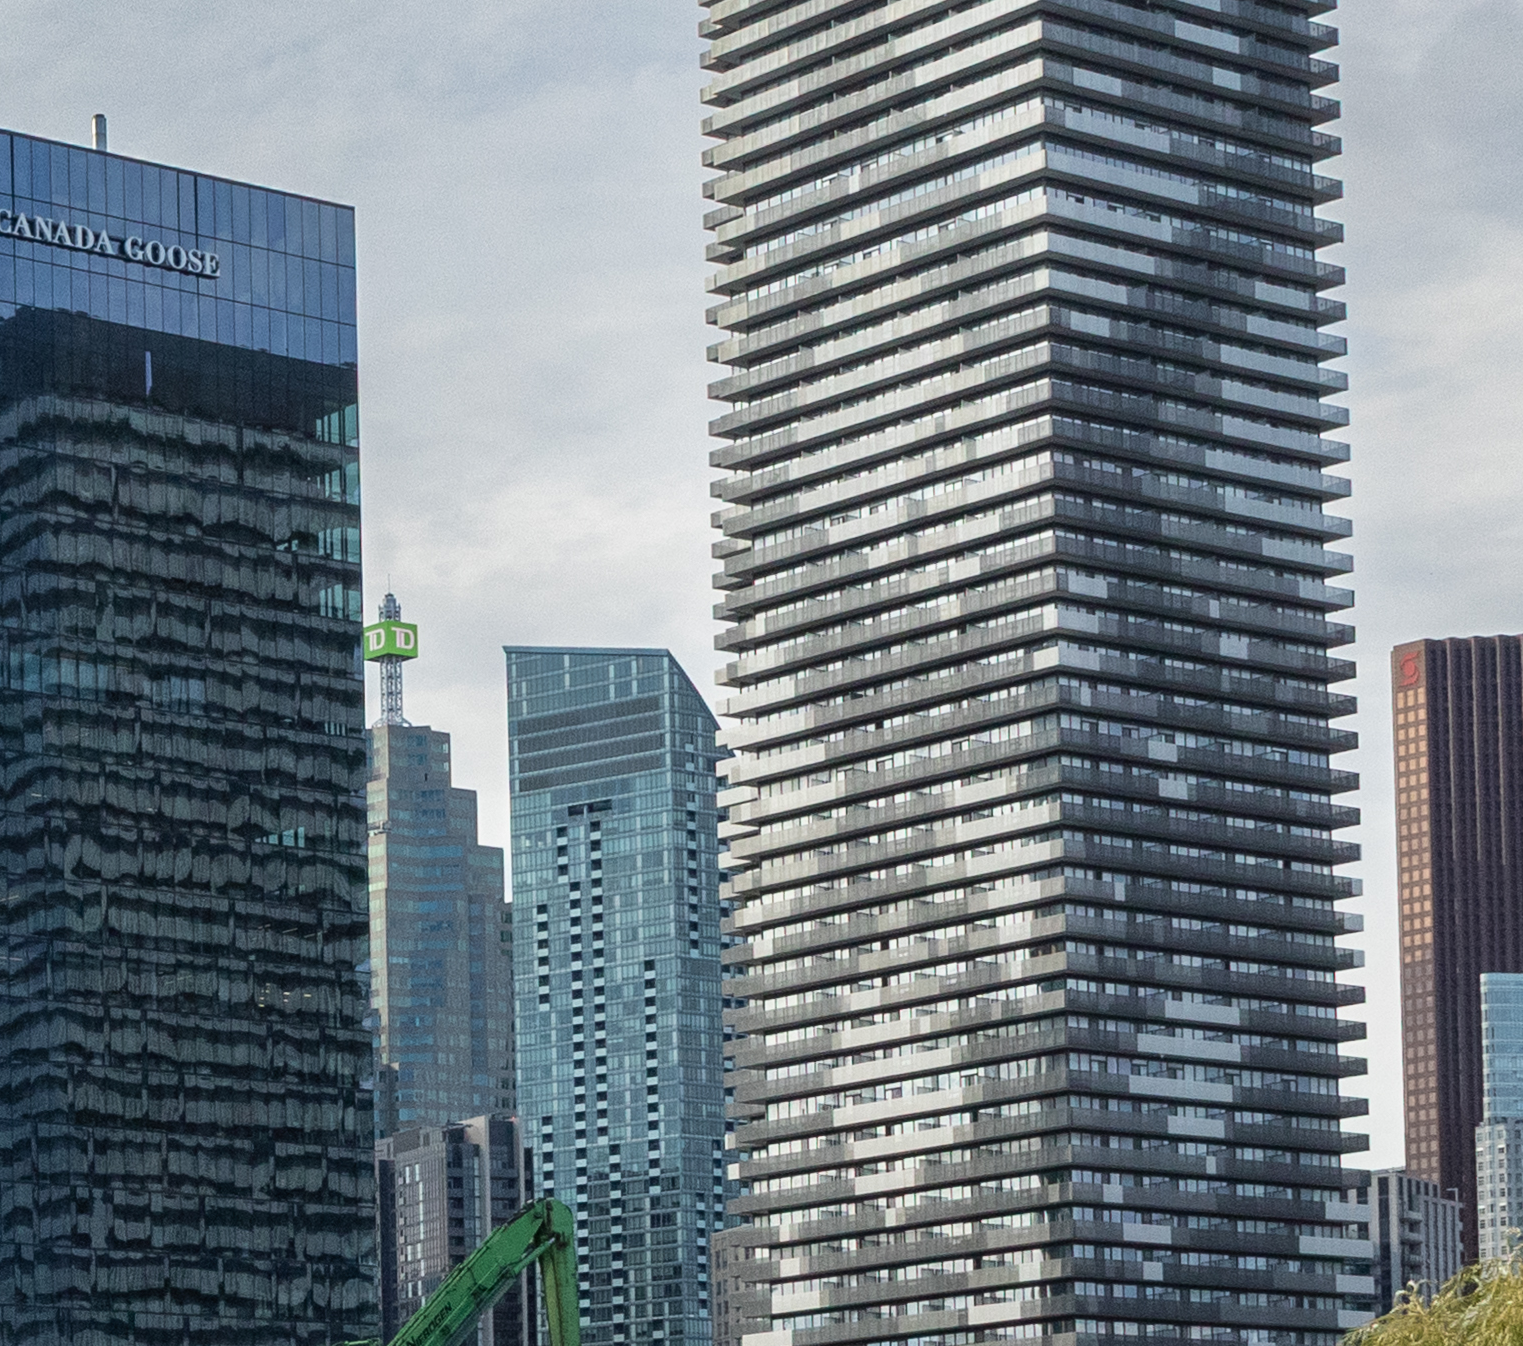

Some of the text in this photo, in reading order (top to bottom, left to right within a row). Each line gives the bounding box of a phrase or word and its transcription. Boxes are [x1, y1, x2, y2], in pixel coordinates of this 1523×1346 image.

[124, 234, 221, 277] GOOSE
[365, 628, 386, 651] TD
[391, 626, 415, 650] TD
